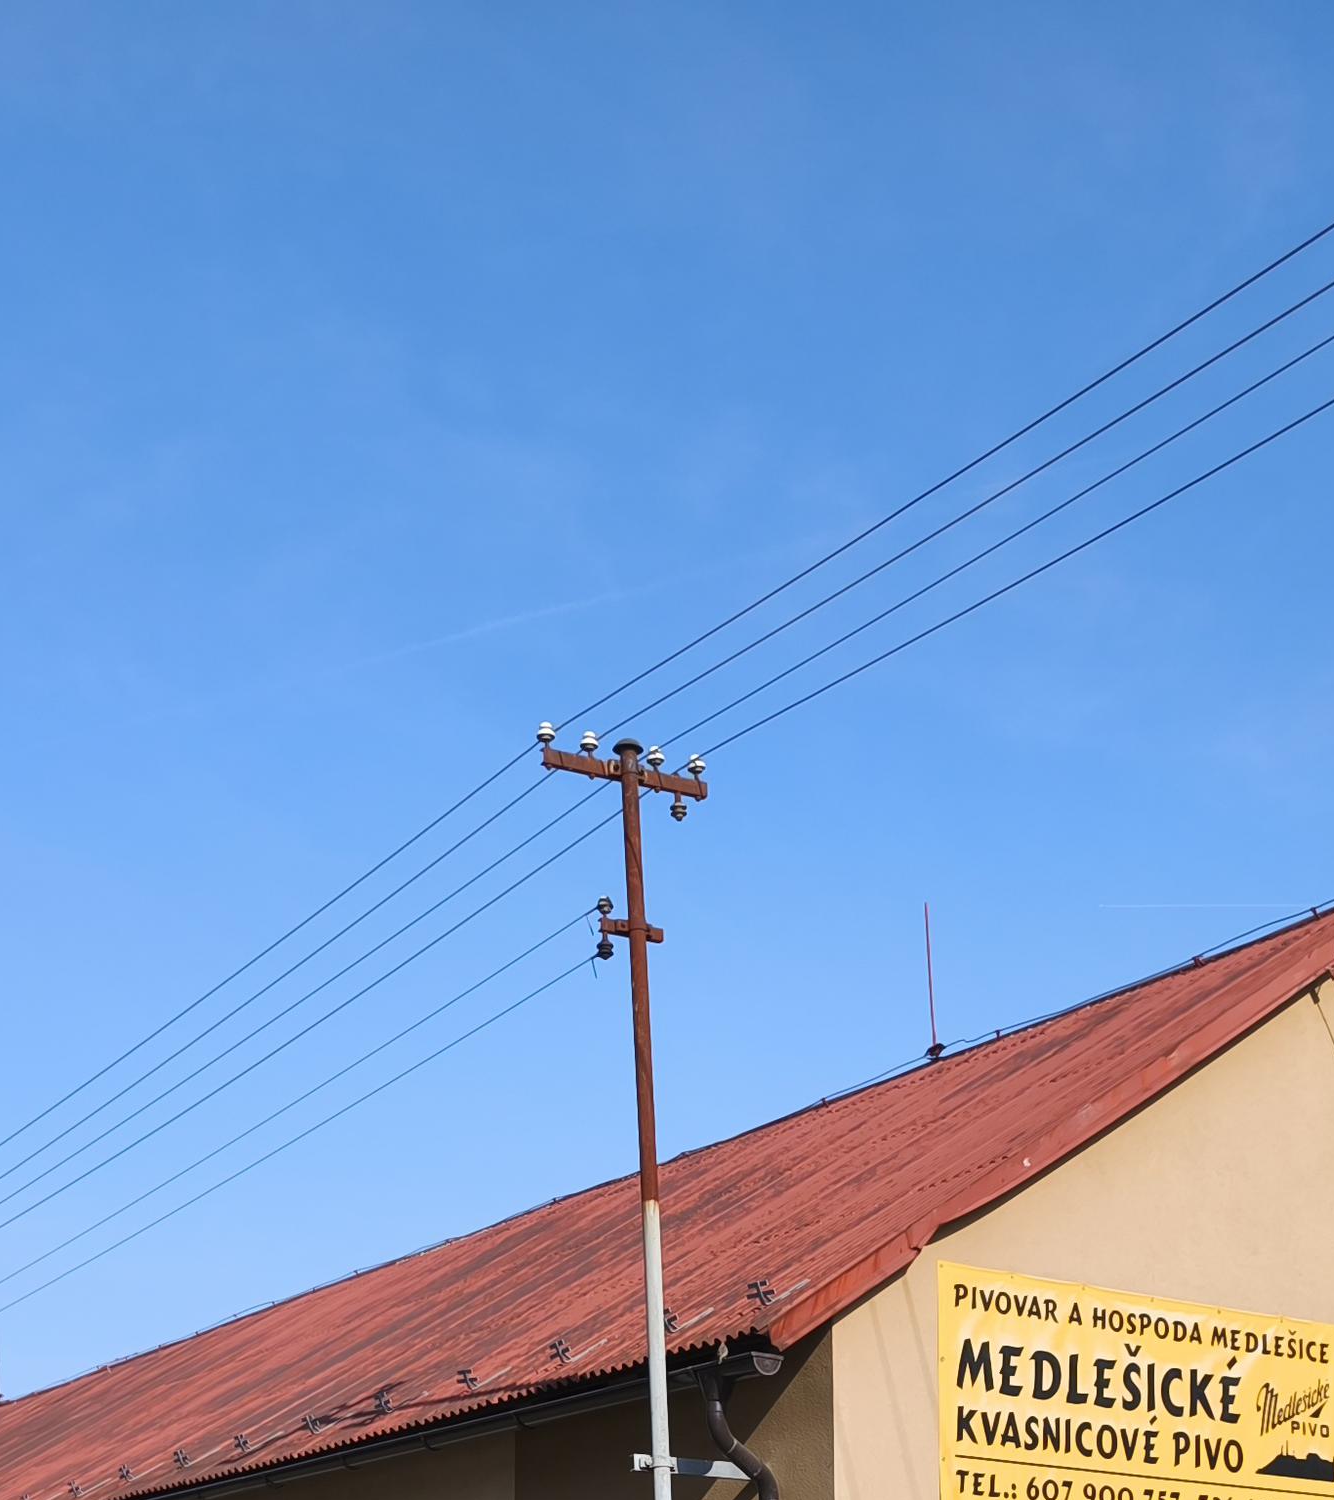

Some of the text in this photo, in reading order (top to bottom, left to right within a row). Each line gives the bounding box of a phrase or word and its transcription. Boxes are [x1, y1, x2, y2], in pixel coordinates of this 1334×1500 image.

[954, 1283, 1330, 1364] PIVOVAR A HOSPODA MEDLEŠICE
[956, 1337, 1242, 1424] MEDLEŠICKÉ
[956, 1405, 1244, 1474] KVASNICOVÉ PIVO
[1290, 1420, 1330, 1439] PIVO
[956, 1469, 1018, 1500] TEL.:
